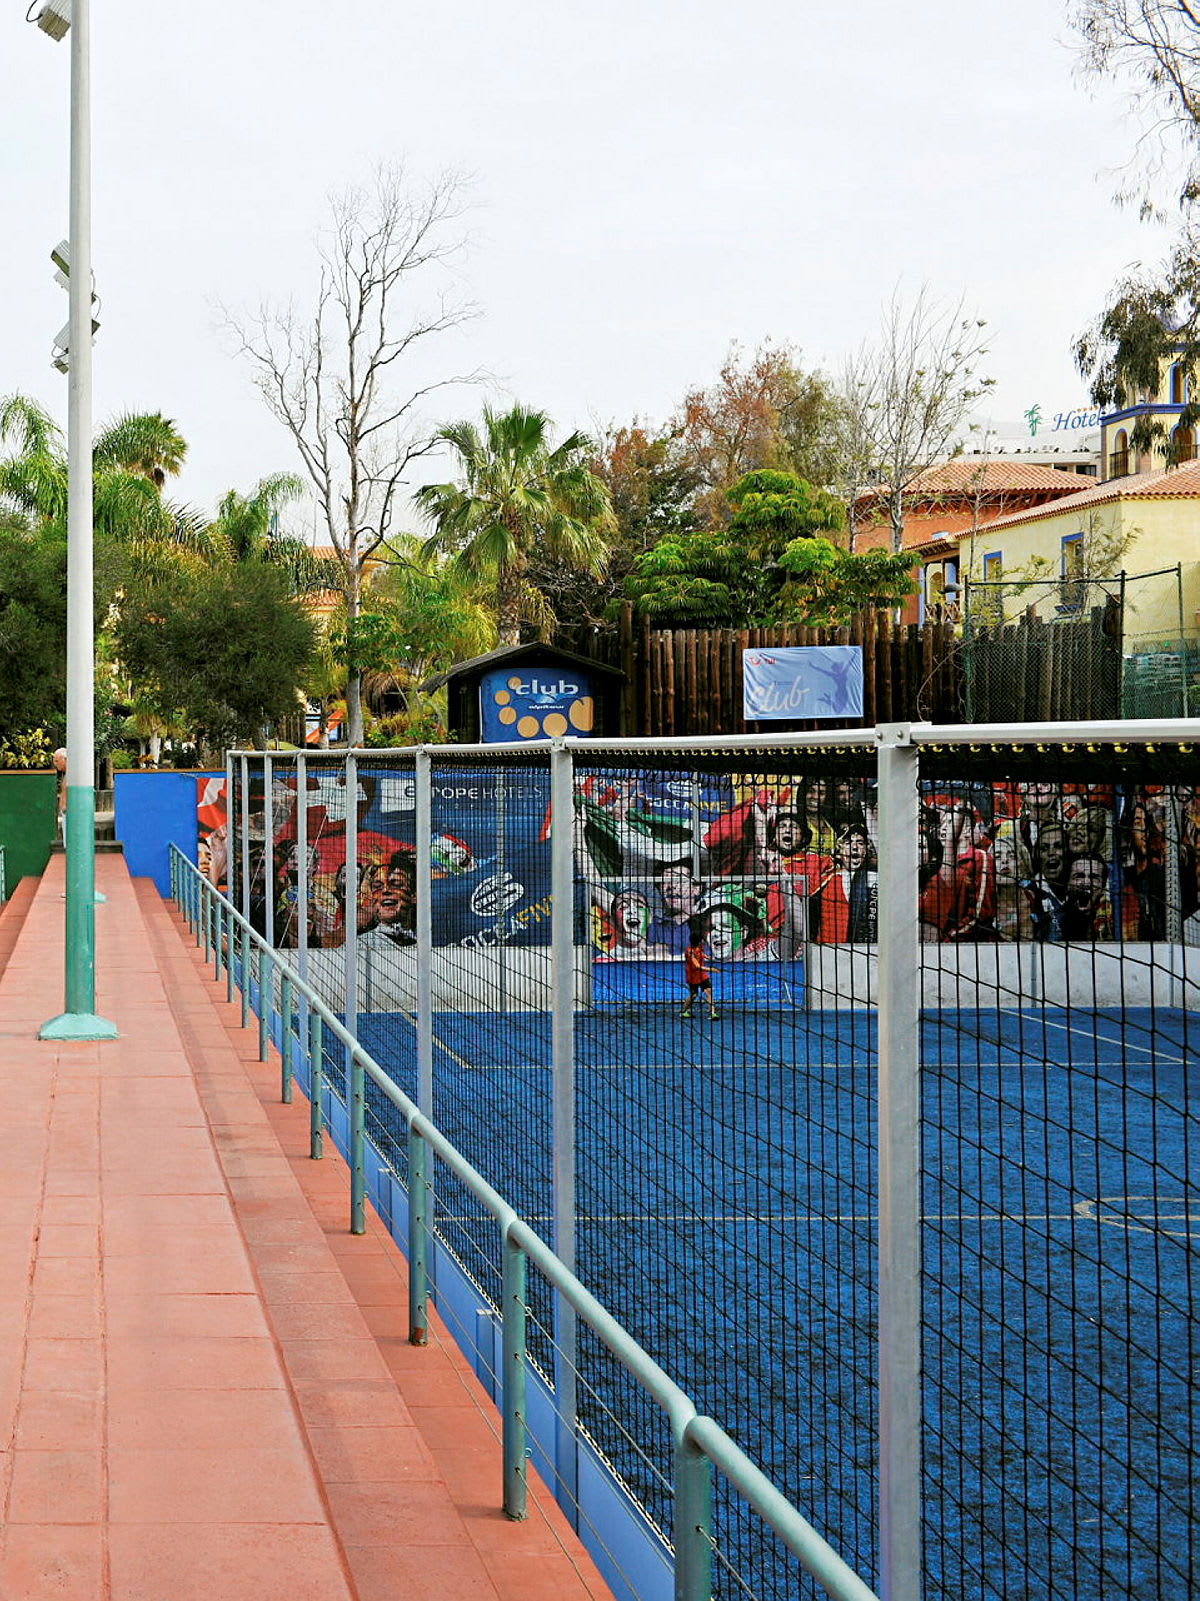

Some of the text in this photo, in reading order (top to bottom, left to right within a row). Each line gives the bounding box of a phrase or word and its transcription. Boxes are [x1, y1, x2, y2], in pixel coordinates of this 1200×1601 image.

[1051, 406, 1101, 432] Hotel
[515, 680, 579, 695] club
[405, 786, 478, 800] EROPE
